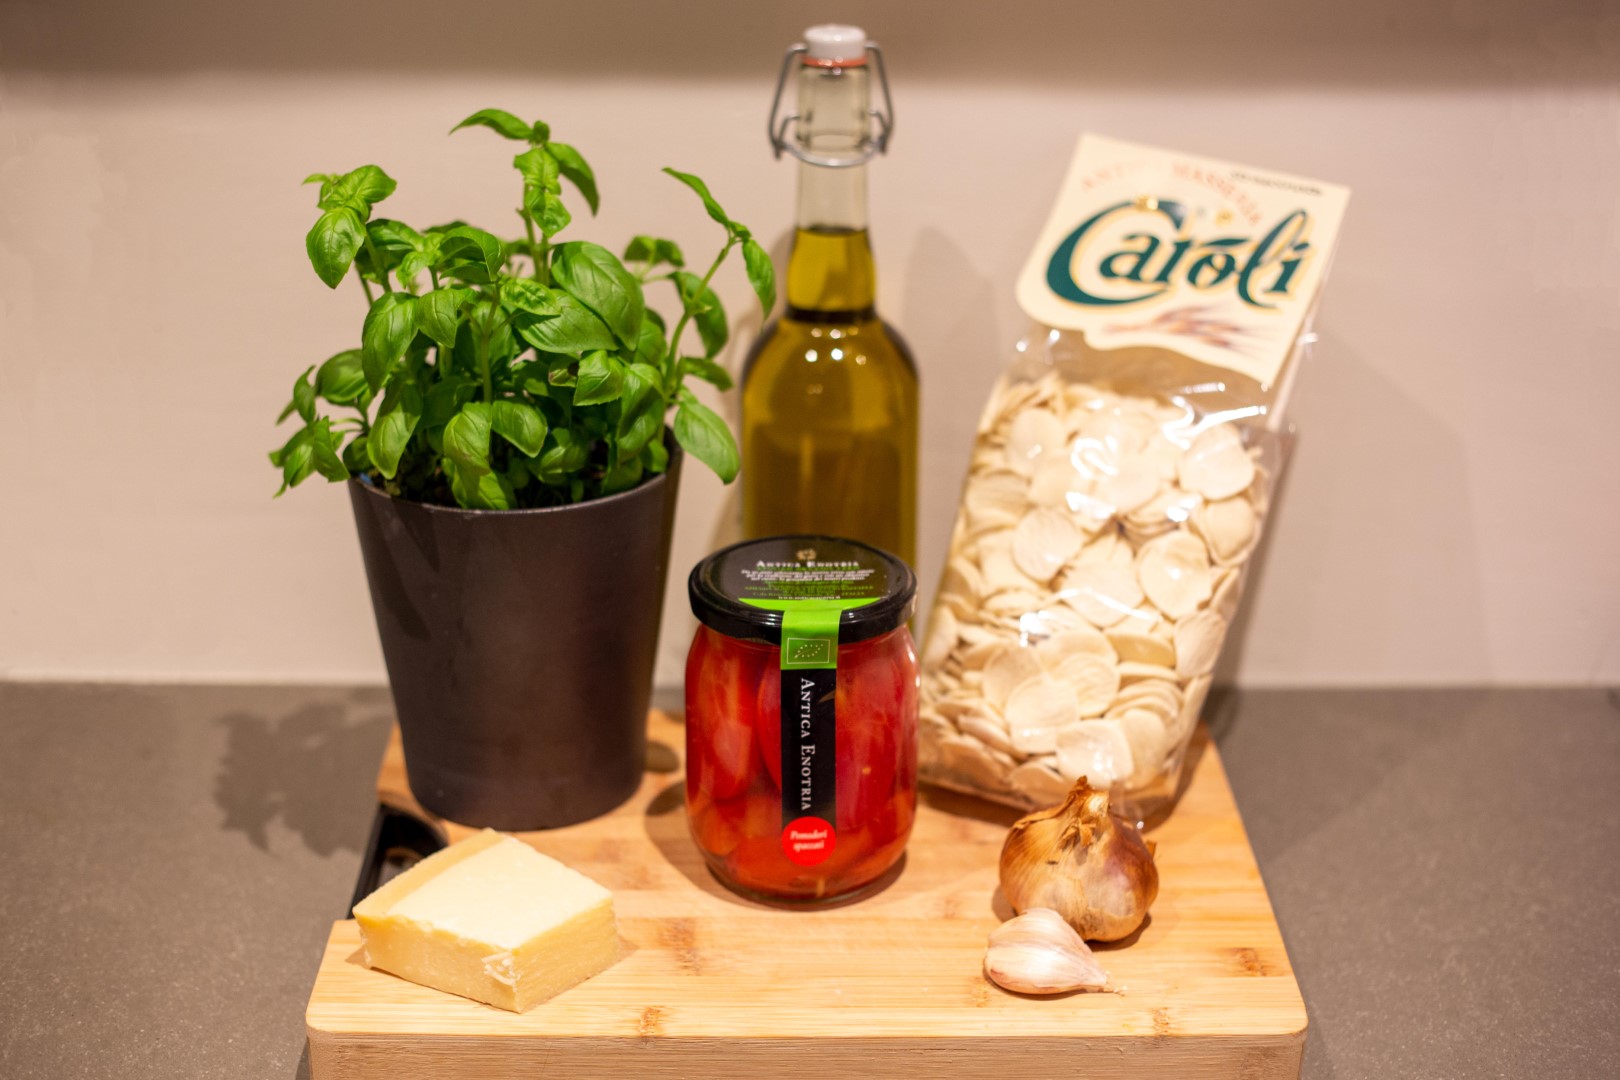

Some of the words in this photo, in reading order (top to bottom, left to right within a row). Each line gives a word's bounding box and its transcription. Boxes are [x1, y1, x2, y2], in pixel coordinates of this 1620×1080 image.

[1046, 195, 1310, 309] Caroli
[800, 678, 816, 738] ANTICA
[800, 744, 816, 811] ENOTRIA
